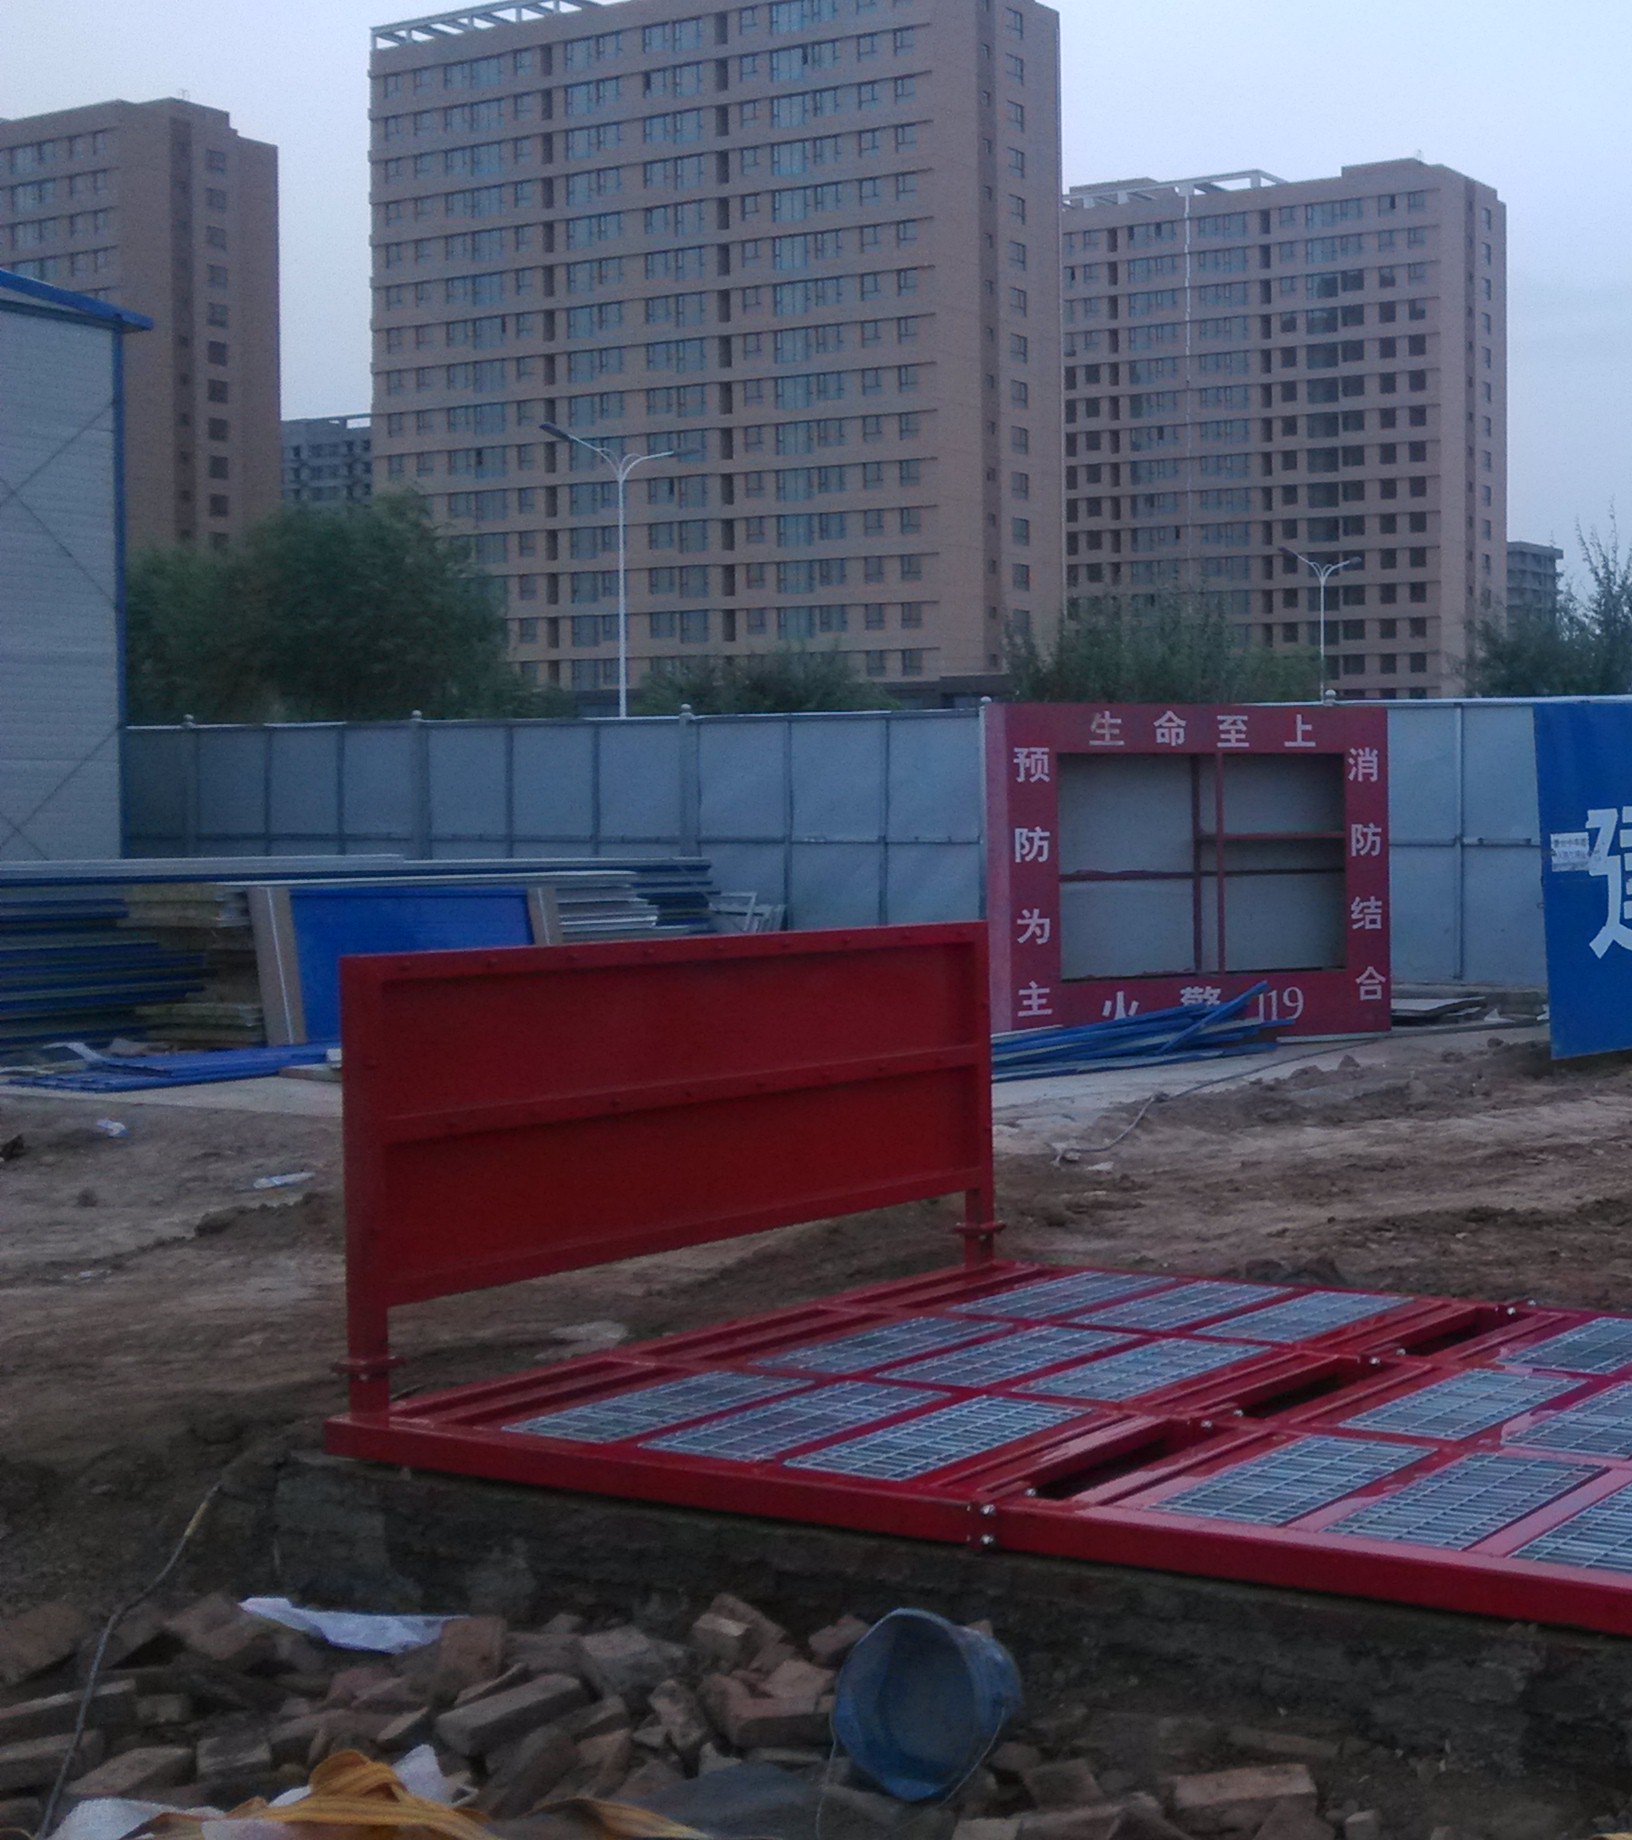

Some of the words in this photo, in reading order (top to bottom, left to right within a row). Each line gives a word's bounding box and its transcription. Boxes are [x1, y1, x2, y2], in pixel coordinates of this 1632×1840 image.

[1089, 710, 1317, 748] 生命至上
[1013, 746, 1053, 1018] 预防为主
[1347, 747, 1387, 1001] 消防结合
